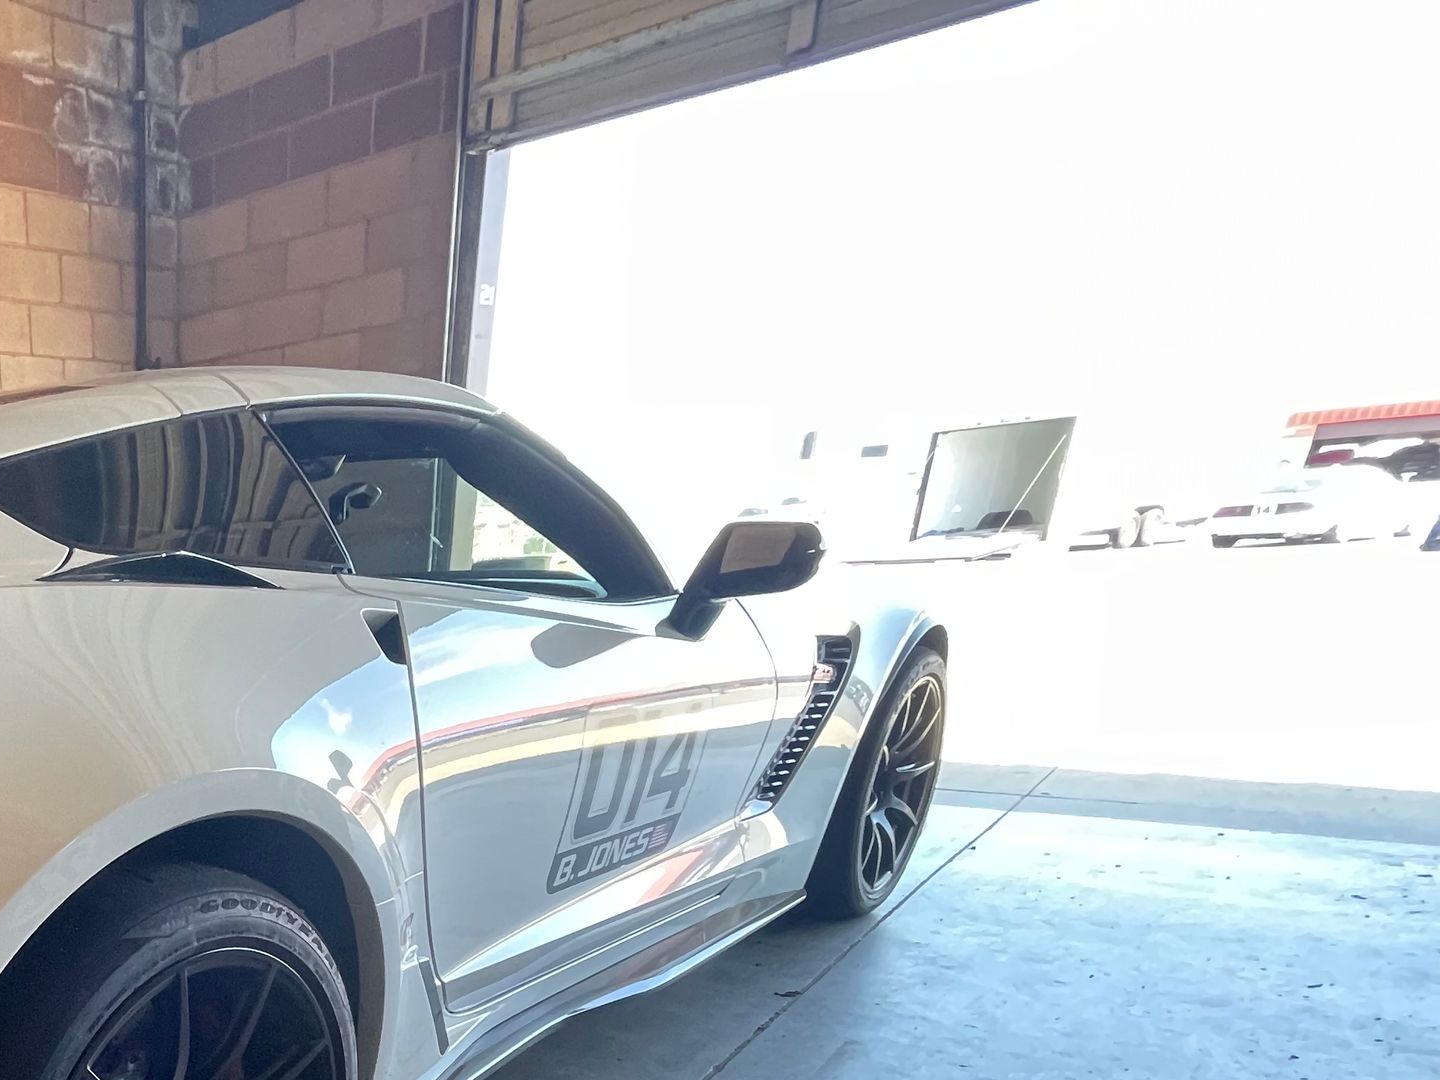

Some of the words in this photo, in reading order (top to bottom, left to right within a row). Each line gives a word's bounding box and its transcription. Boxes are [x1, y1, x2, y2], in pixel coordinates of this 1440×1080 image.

[552, 853, 575, 887] B.
[577, 826, 655, 878] JONES
[199, 897, 336, 971] GOODYEAR
